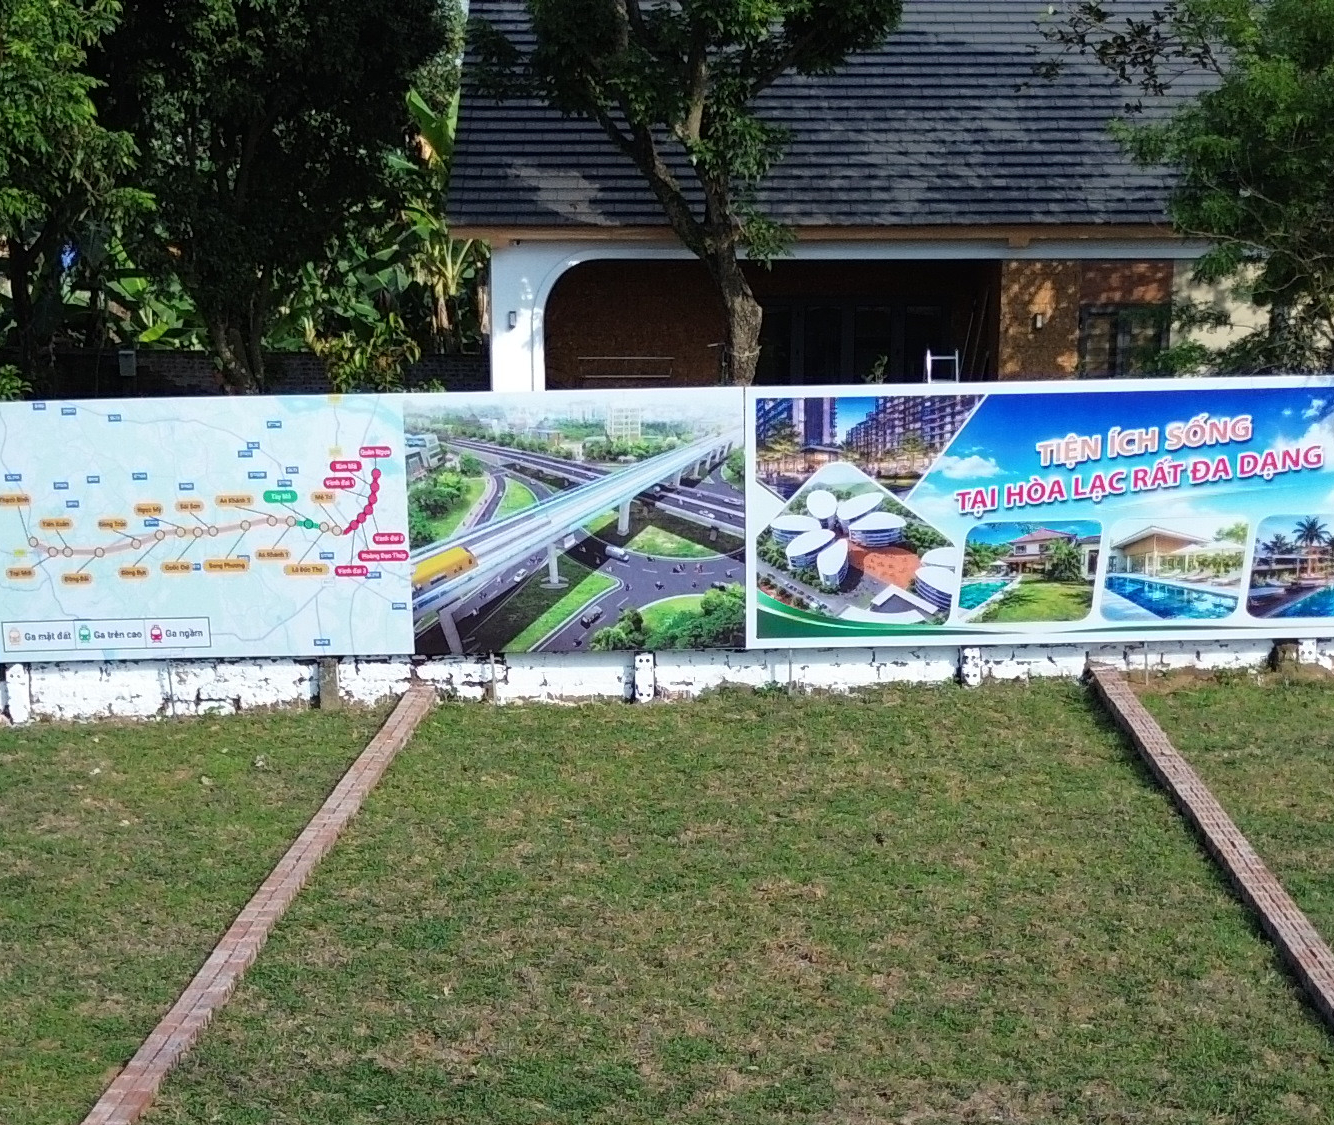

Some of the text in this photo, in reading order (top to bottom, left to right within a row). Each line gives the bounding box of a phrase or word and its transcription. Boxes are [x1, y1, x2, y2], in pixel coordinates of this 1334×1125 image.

[1036, 412, 1252, 469] TIỆN ÍCH SỐNG
[955, 444, 1324, 517] TẠI HÒA LẠC RẤT ĐA DẠNG
[24, 633, 36, 641] Ga
[94, 631, 106, 639] Ga
[107, 630, 125, 639] trên
[165, 630, 177, 638] Ga
